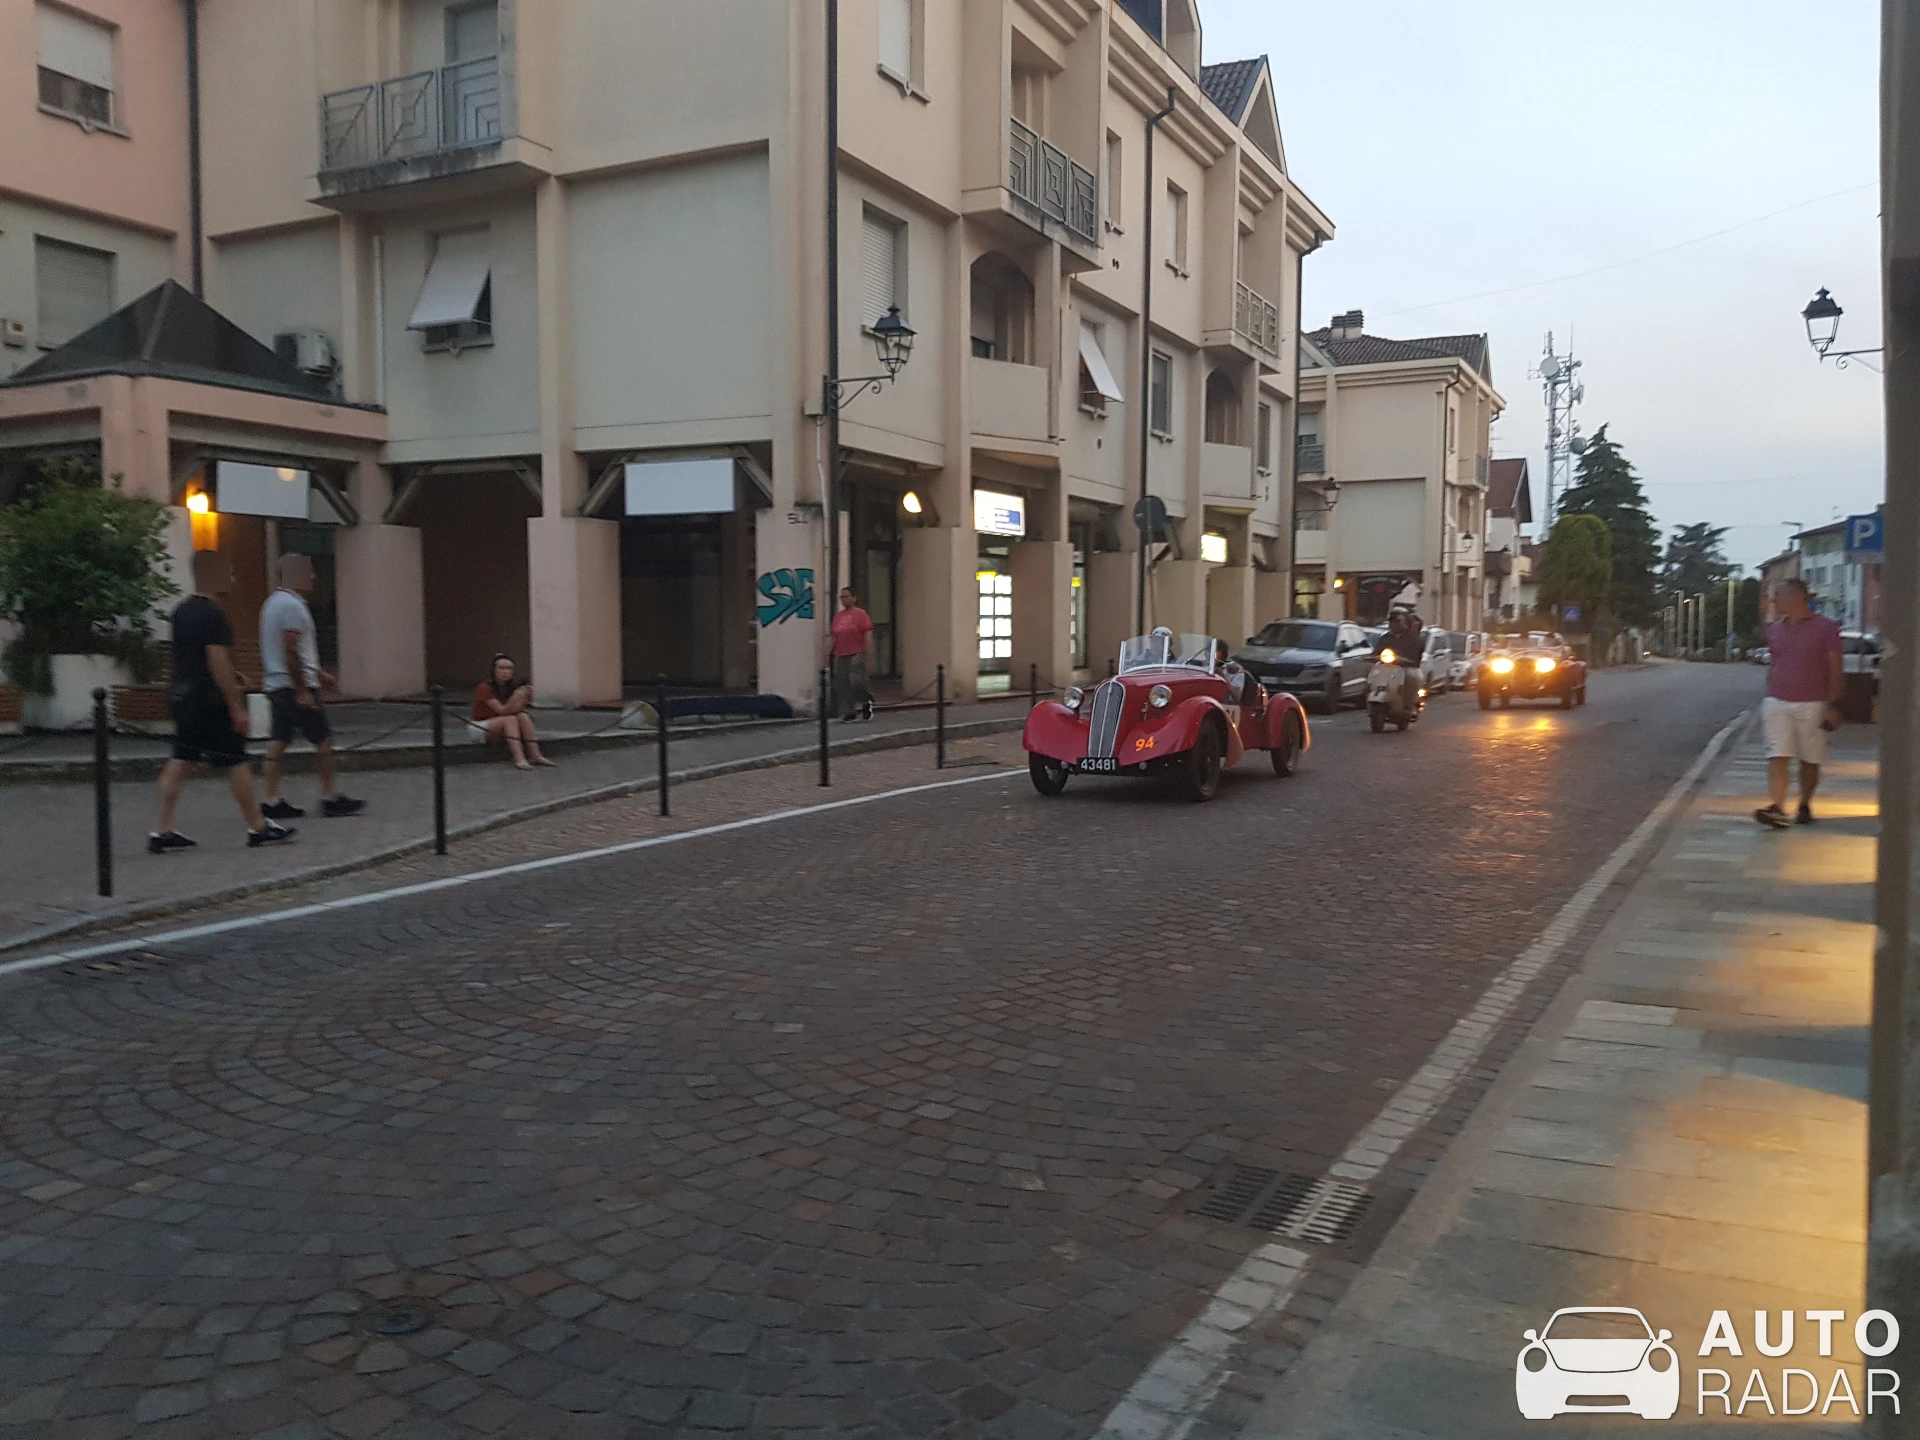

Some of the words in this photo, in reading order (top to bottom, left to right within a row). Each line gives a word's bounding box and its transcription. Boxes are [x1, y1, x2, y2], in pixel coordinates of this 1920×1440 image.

[1852, 518, 1876, 548] P
[1135, 736, 1155, 751] 94
[1080, 758, 1116, 770] 43481
